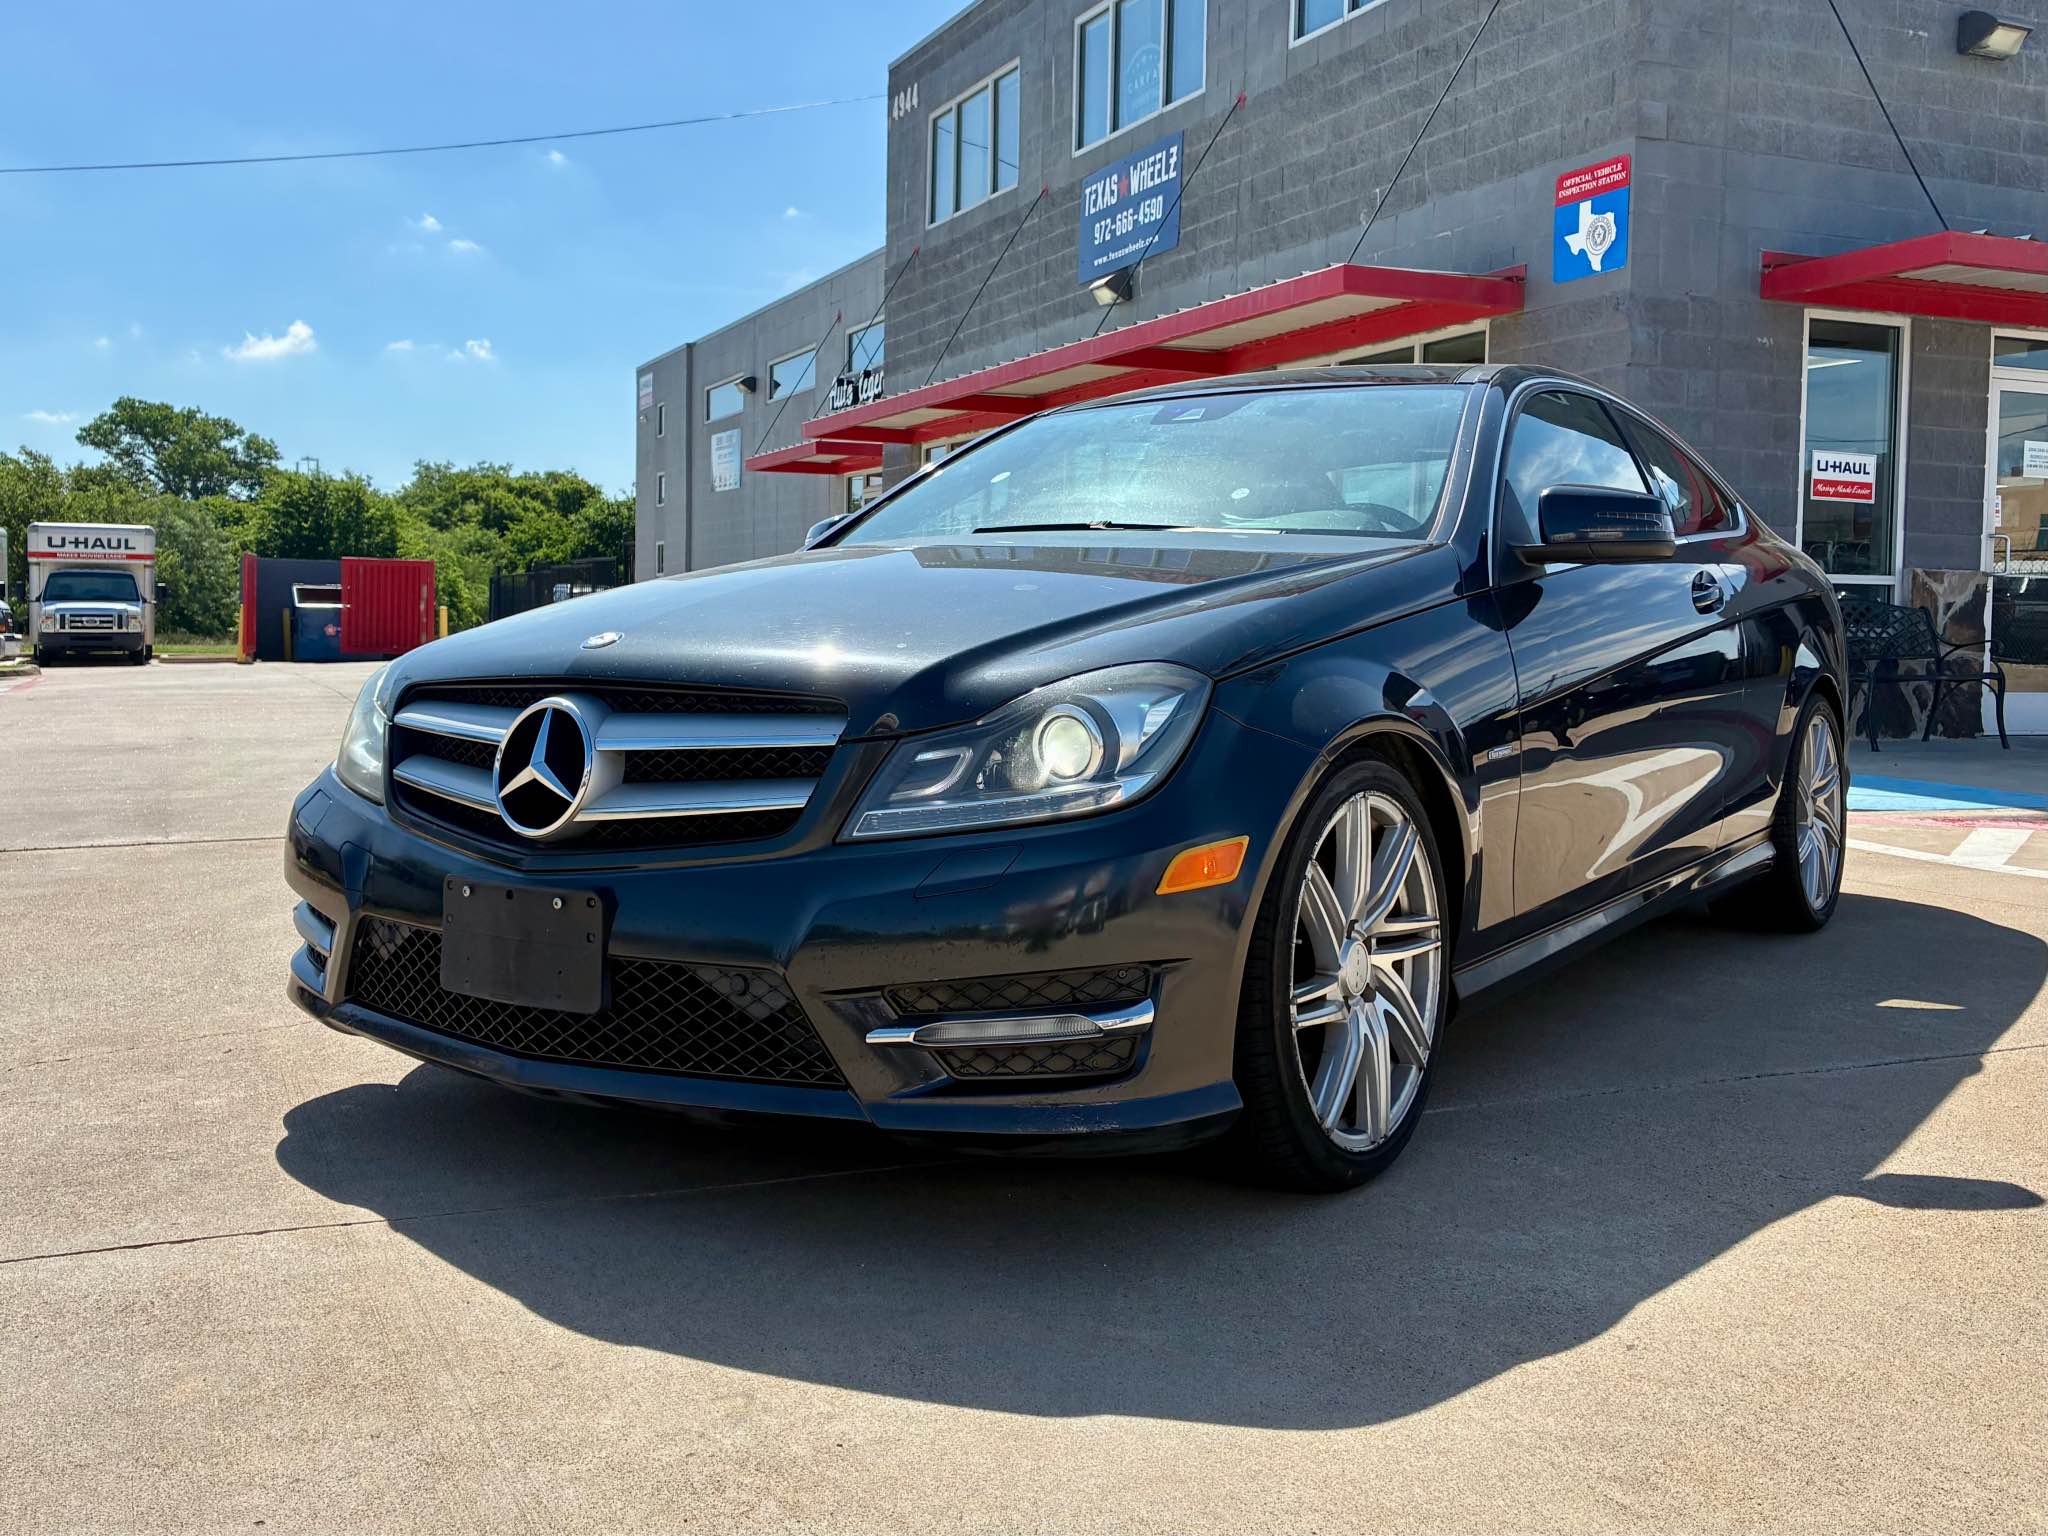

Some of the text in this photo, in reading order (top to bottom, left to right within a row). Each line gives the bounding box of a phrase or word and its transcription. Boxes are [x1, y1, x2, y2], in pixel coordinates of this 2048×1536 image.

[893, 82, 918, 120] 4944
[1085, 145, 1178, 217] TEXAS WHEELZ
[1558, 171, 1627, 198] INSPECTION STATION
[1563, 162, 1623, 187] OFFICIAL VEHICLE
[1094, 195, 1163, 245] 972-666-4590
[828, 376, 853, 410] Auto
[1817, 460, 1871, 475] U-HAUL
[47, 536, 136, 550] U-HAUL
